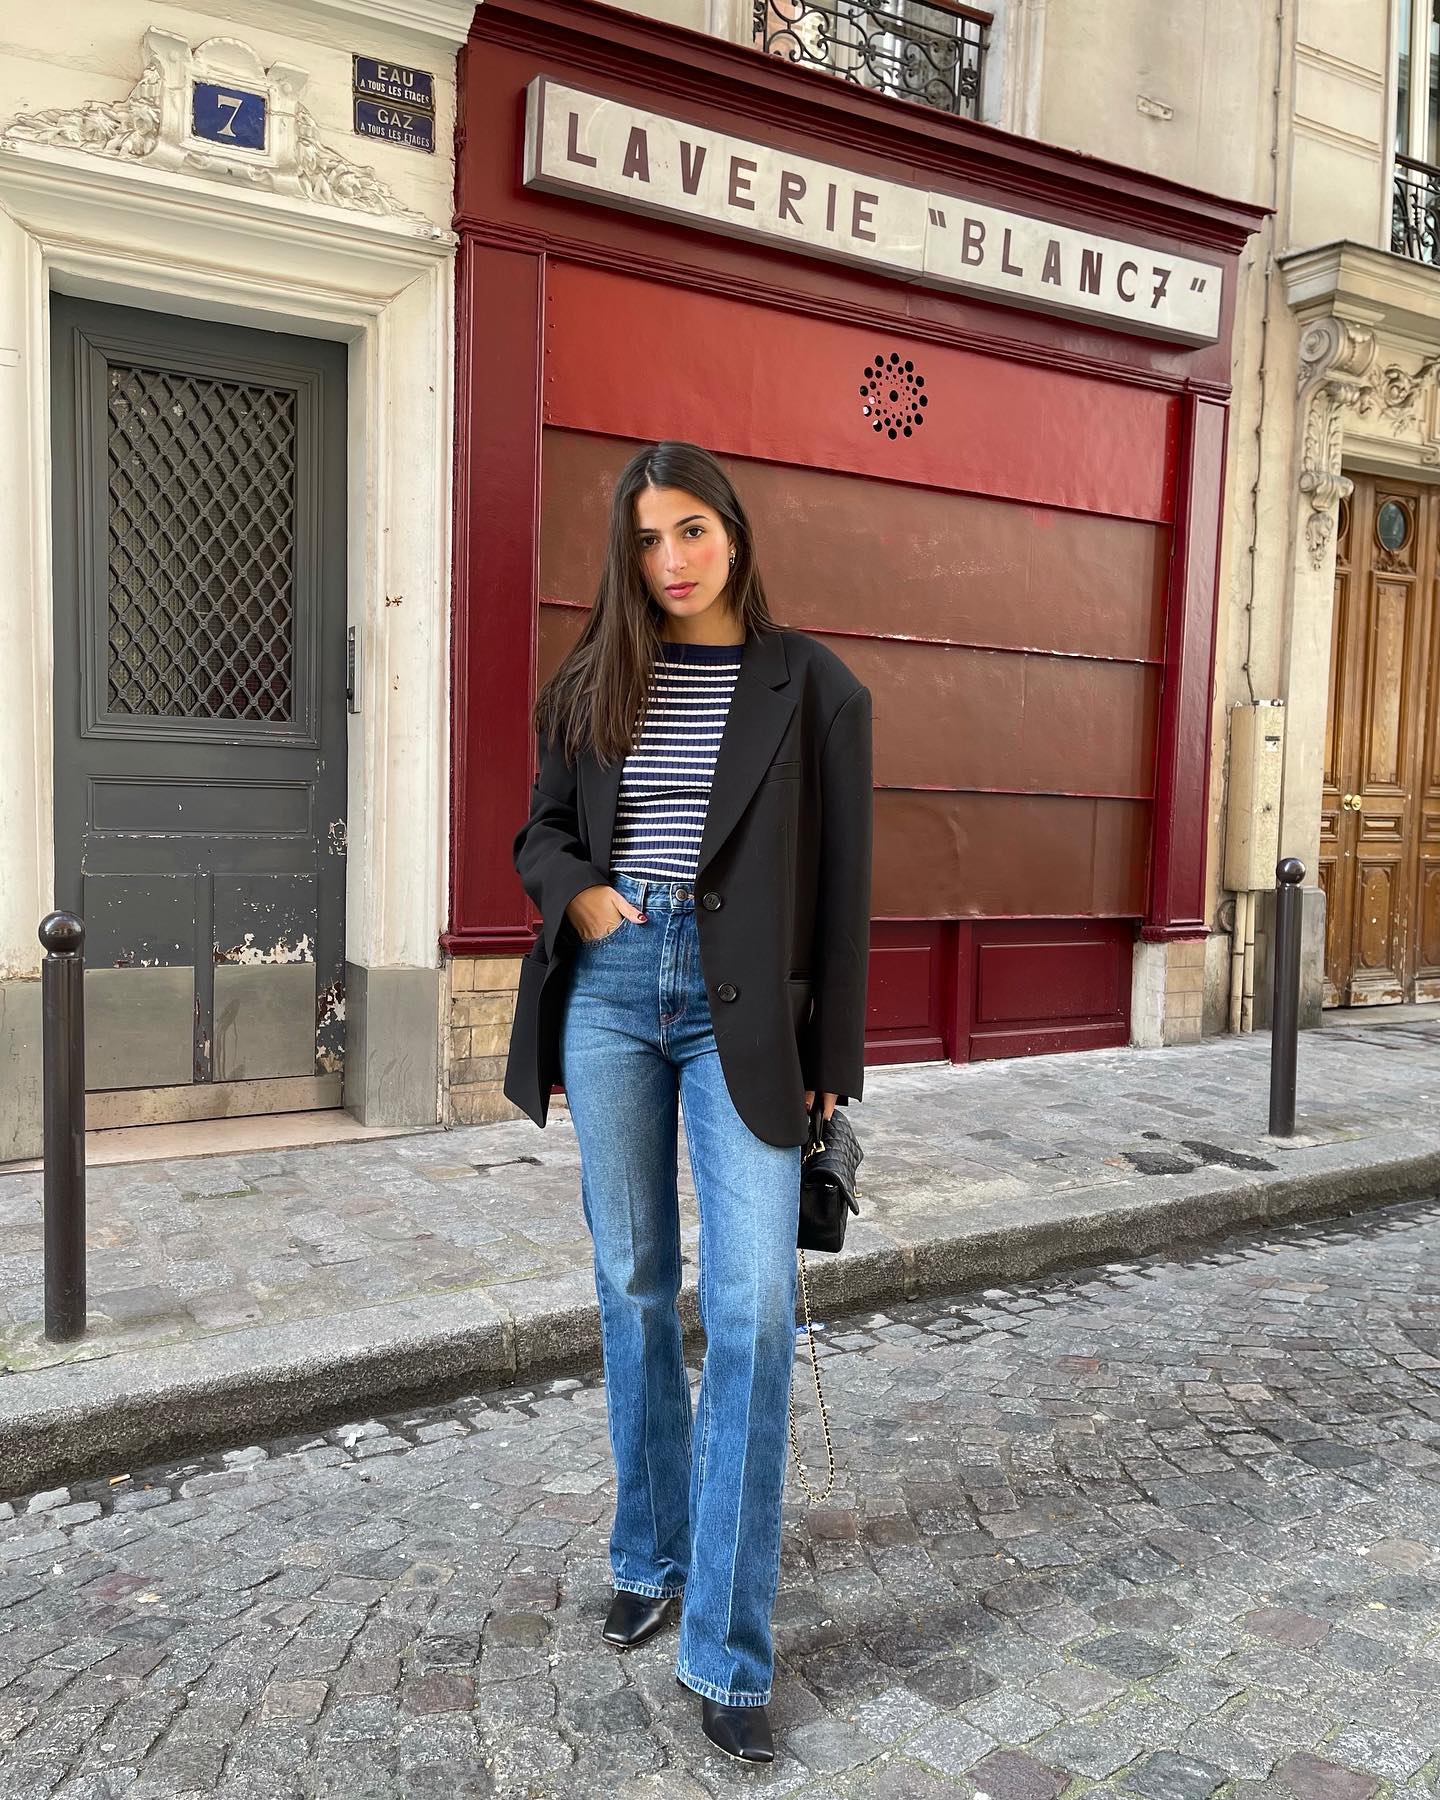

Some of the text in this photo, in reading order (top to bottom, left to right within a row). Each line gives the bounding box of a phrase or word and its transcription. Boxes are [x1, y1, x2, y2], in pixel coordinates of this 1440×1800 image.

[377, 64, 414, 87] EAU
[360, 78, 366, 88] A
[367, 79, 386, 93] TOUS
[388, 85, 402, 97] LES
[216, 94, 243, 138] 7
[377, 109, 414, 130] GAZ
[360, 122, 366, 131] A
[367, 123, 386, 136] TOUS
[388, 128, 401, 141] LES
[566, 111, 879, 243] LAVERIE
